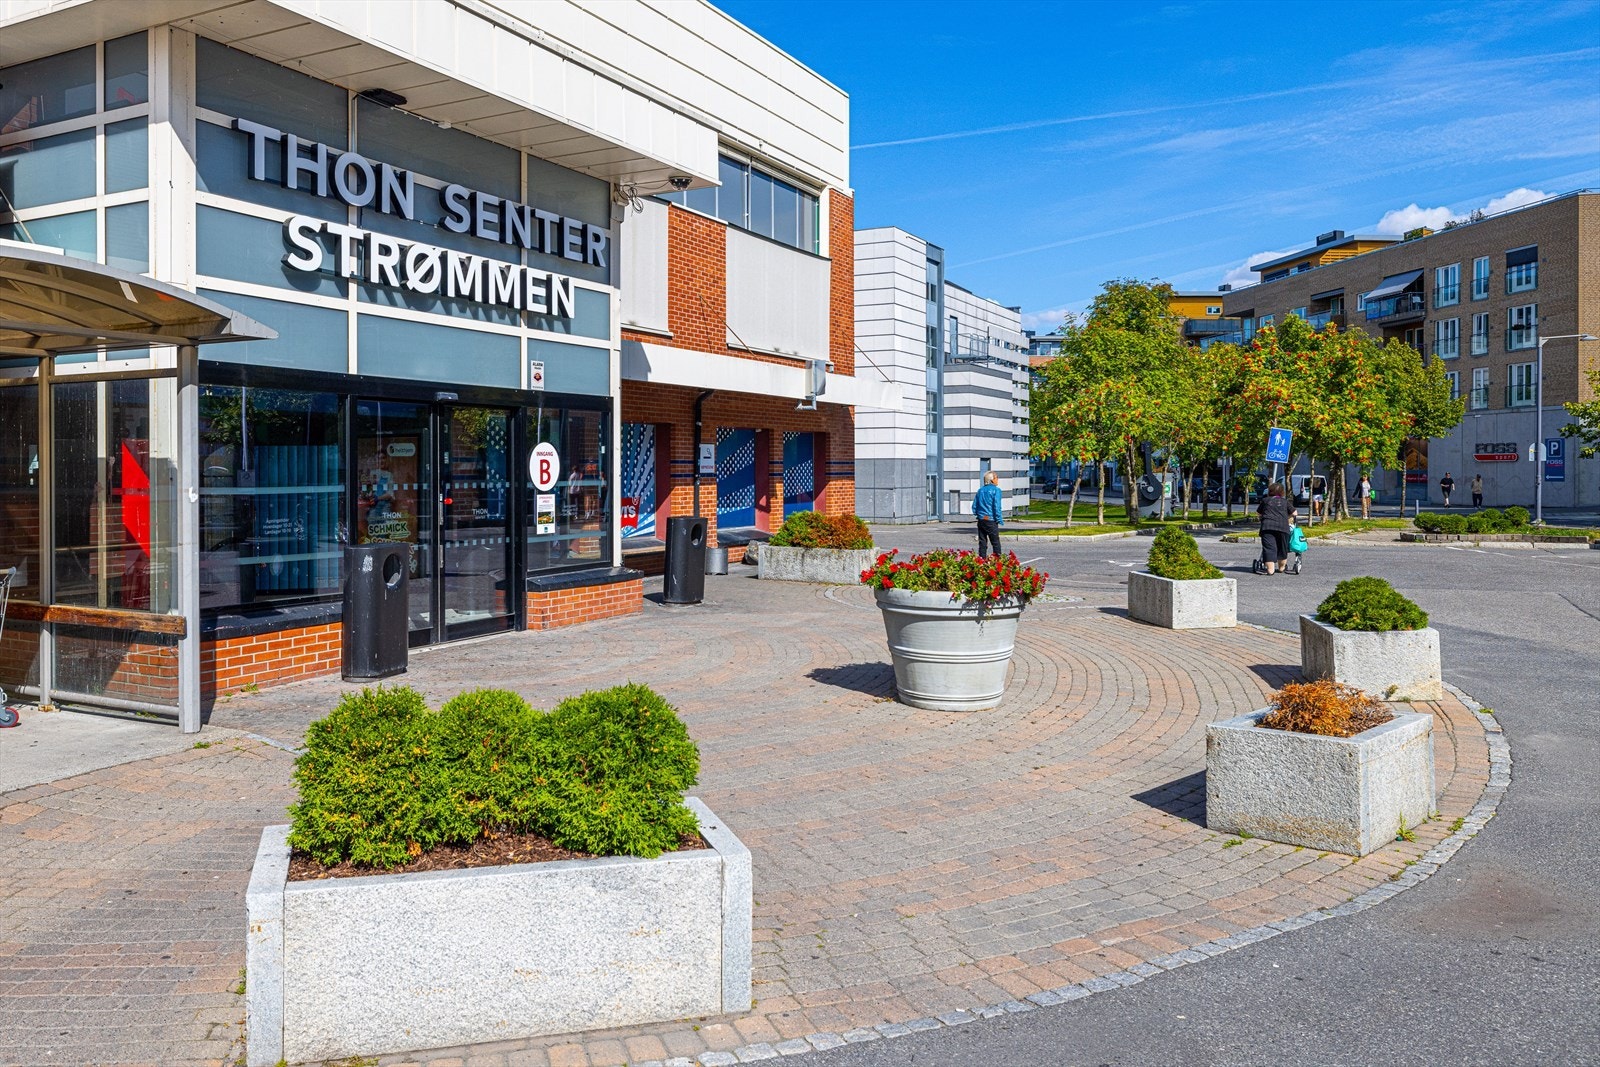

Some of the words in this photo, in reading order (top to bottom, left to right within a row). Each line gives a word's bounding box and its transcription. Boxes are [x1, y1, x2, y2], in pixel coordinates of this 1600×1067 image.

[232, 117, 414, 221] THON
[440, 184, 607, 268] SENTER
[282, 215, 575, 319] STRØMMEN
[1475, 442, 1517, 453] FOSS
[1550, 442, 1559, 455] P
[540, 459, 551, 485] B
[369, 522, 407, 534] SCHMICK
